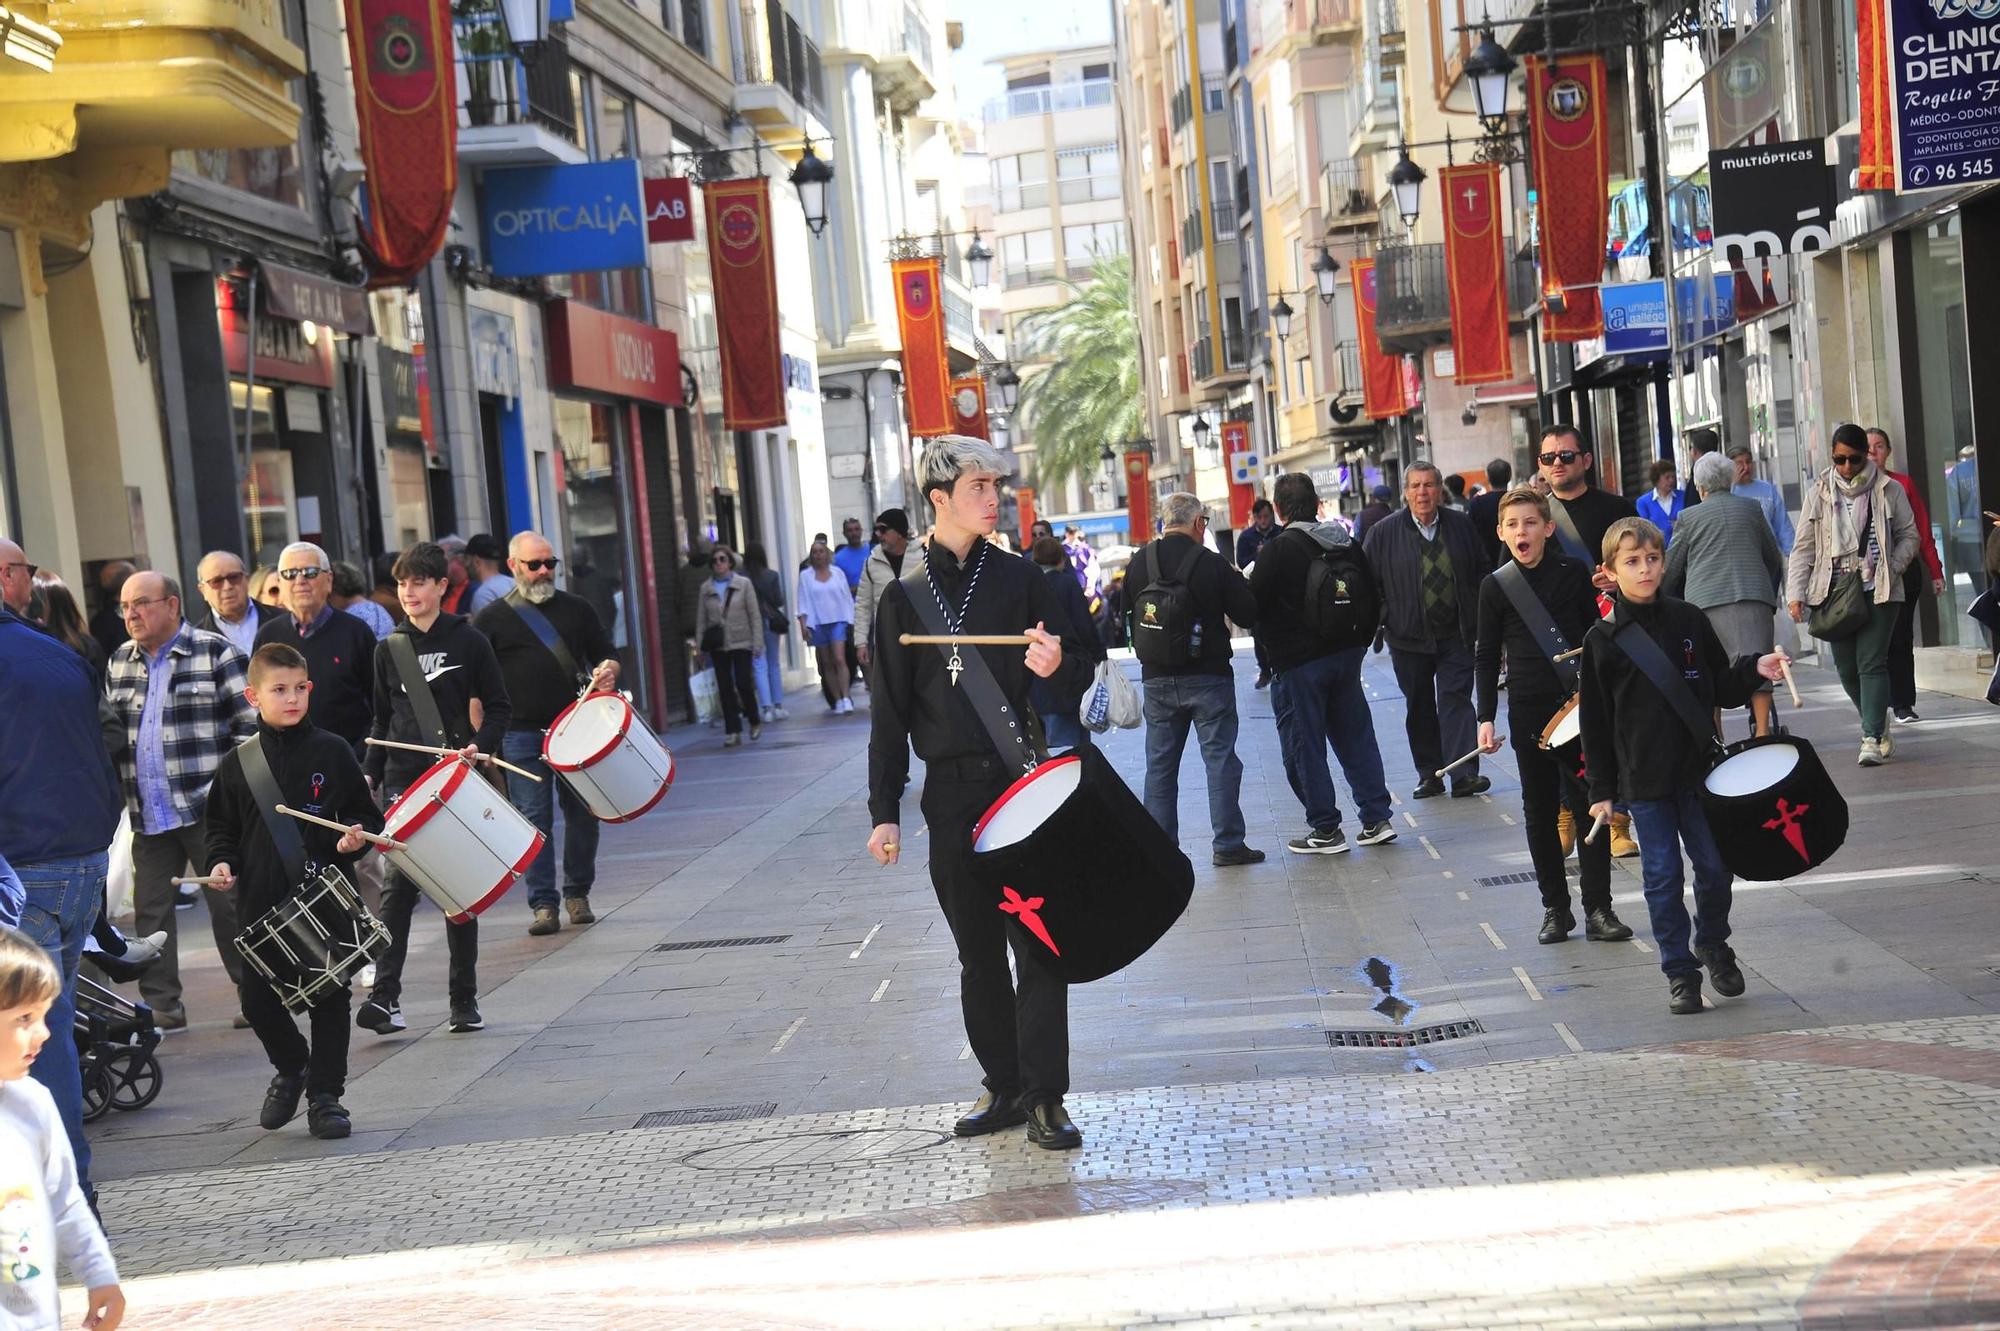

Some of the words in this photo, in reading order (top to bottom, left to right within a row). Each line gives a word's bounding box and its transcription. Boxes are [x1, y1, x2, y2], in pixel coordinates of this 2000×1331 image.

[1904, 88, 1972, 111] Rogelio
[1910, 106, 2000, 127] MÉDICO-ODONT
[1917, 127, 1989, 145] ODONTOLOGÍA
[1914, 142, 1964, 156] IMPLANTES
[1935, 163, 1956, 181] 96
[1962, 158, 1993, 177] 545
